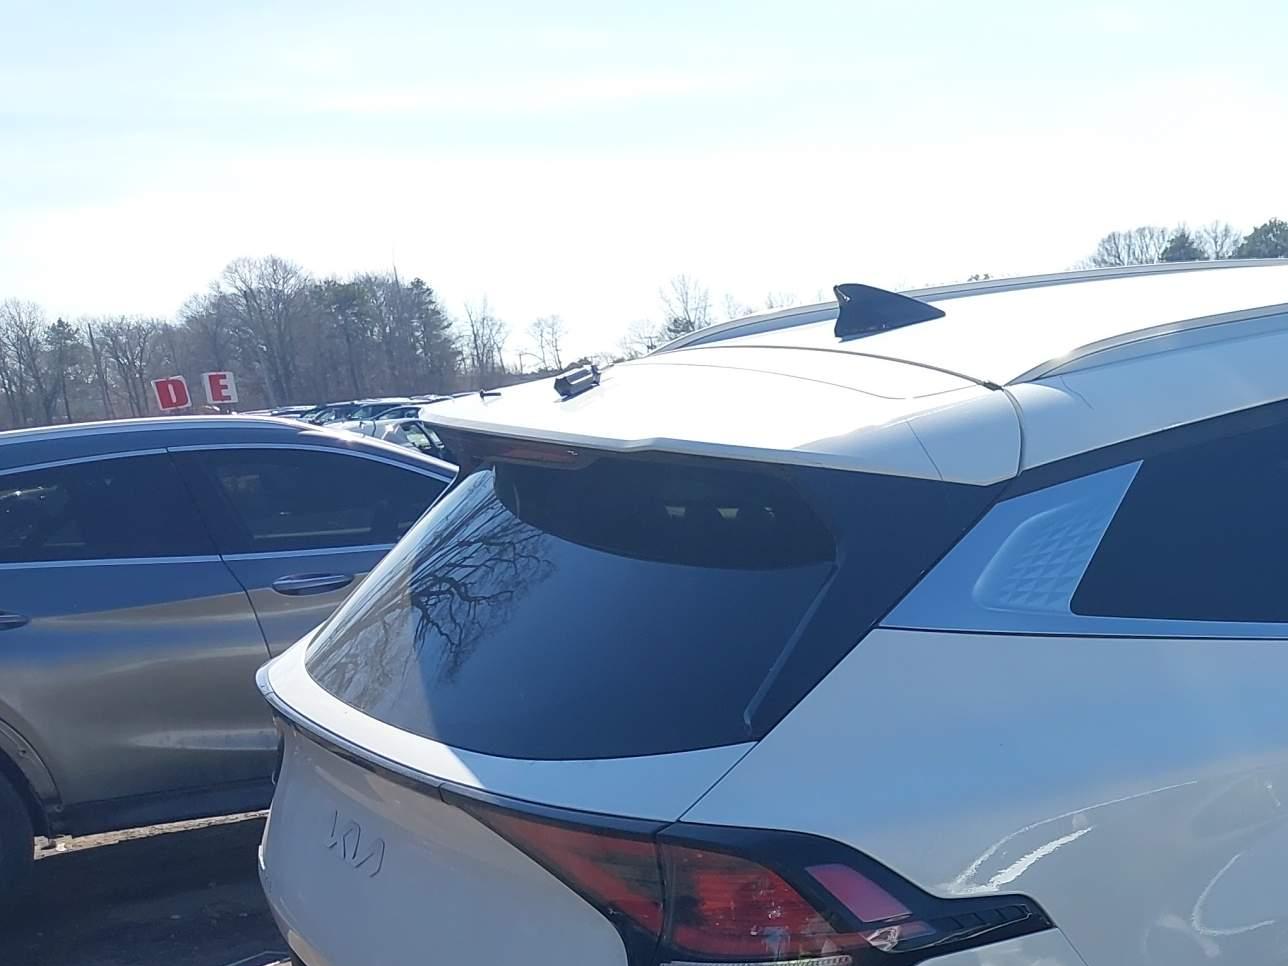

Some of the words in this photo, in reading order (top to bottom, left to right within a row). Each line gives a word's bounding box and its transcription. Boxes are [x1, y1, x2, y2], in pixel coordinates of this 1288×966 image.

[155, 379, 189, 409] D
[208, 374, 232, 402] E
[326, 809, 386, 878] KIA
